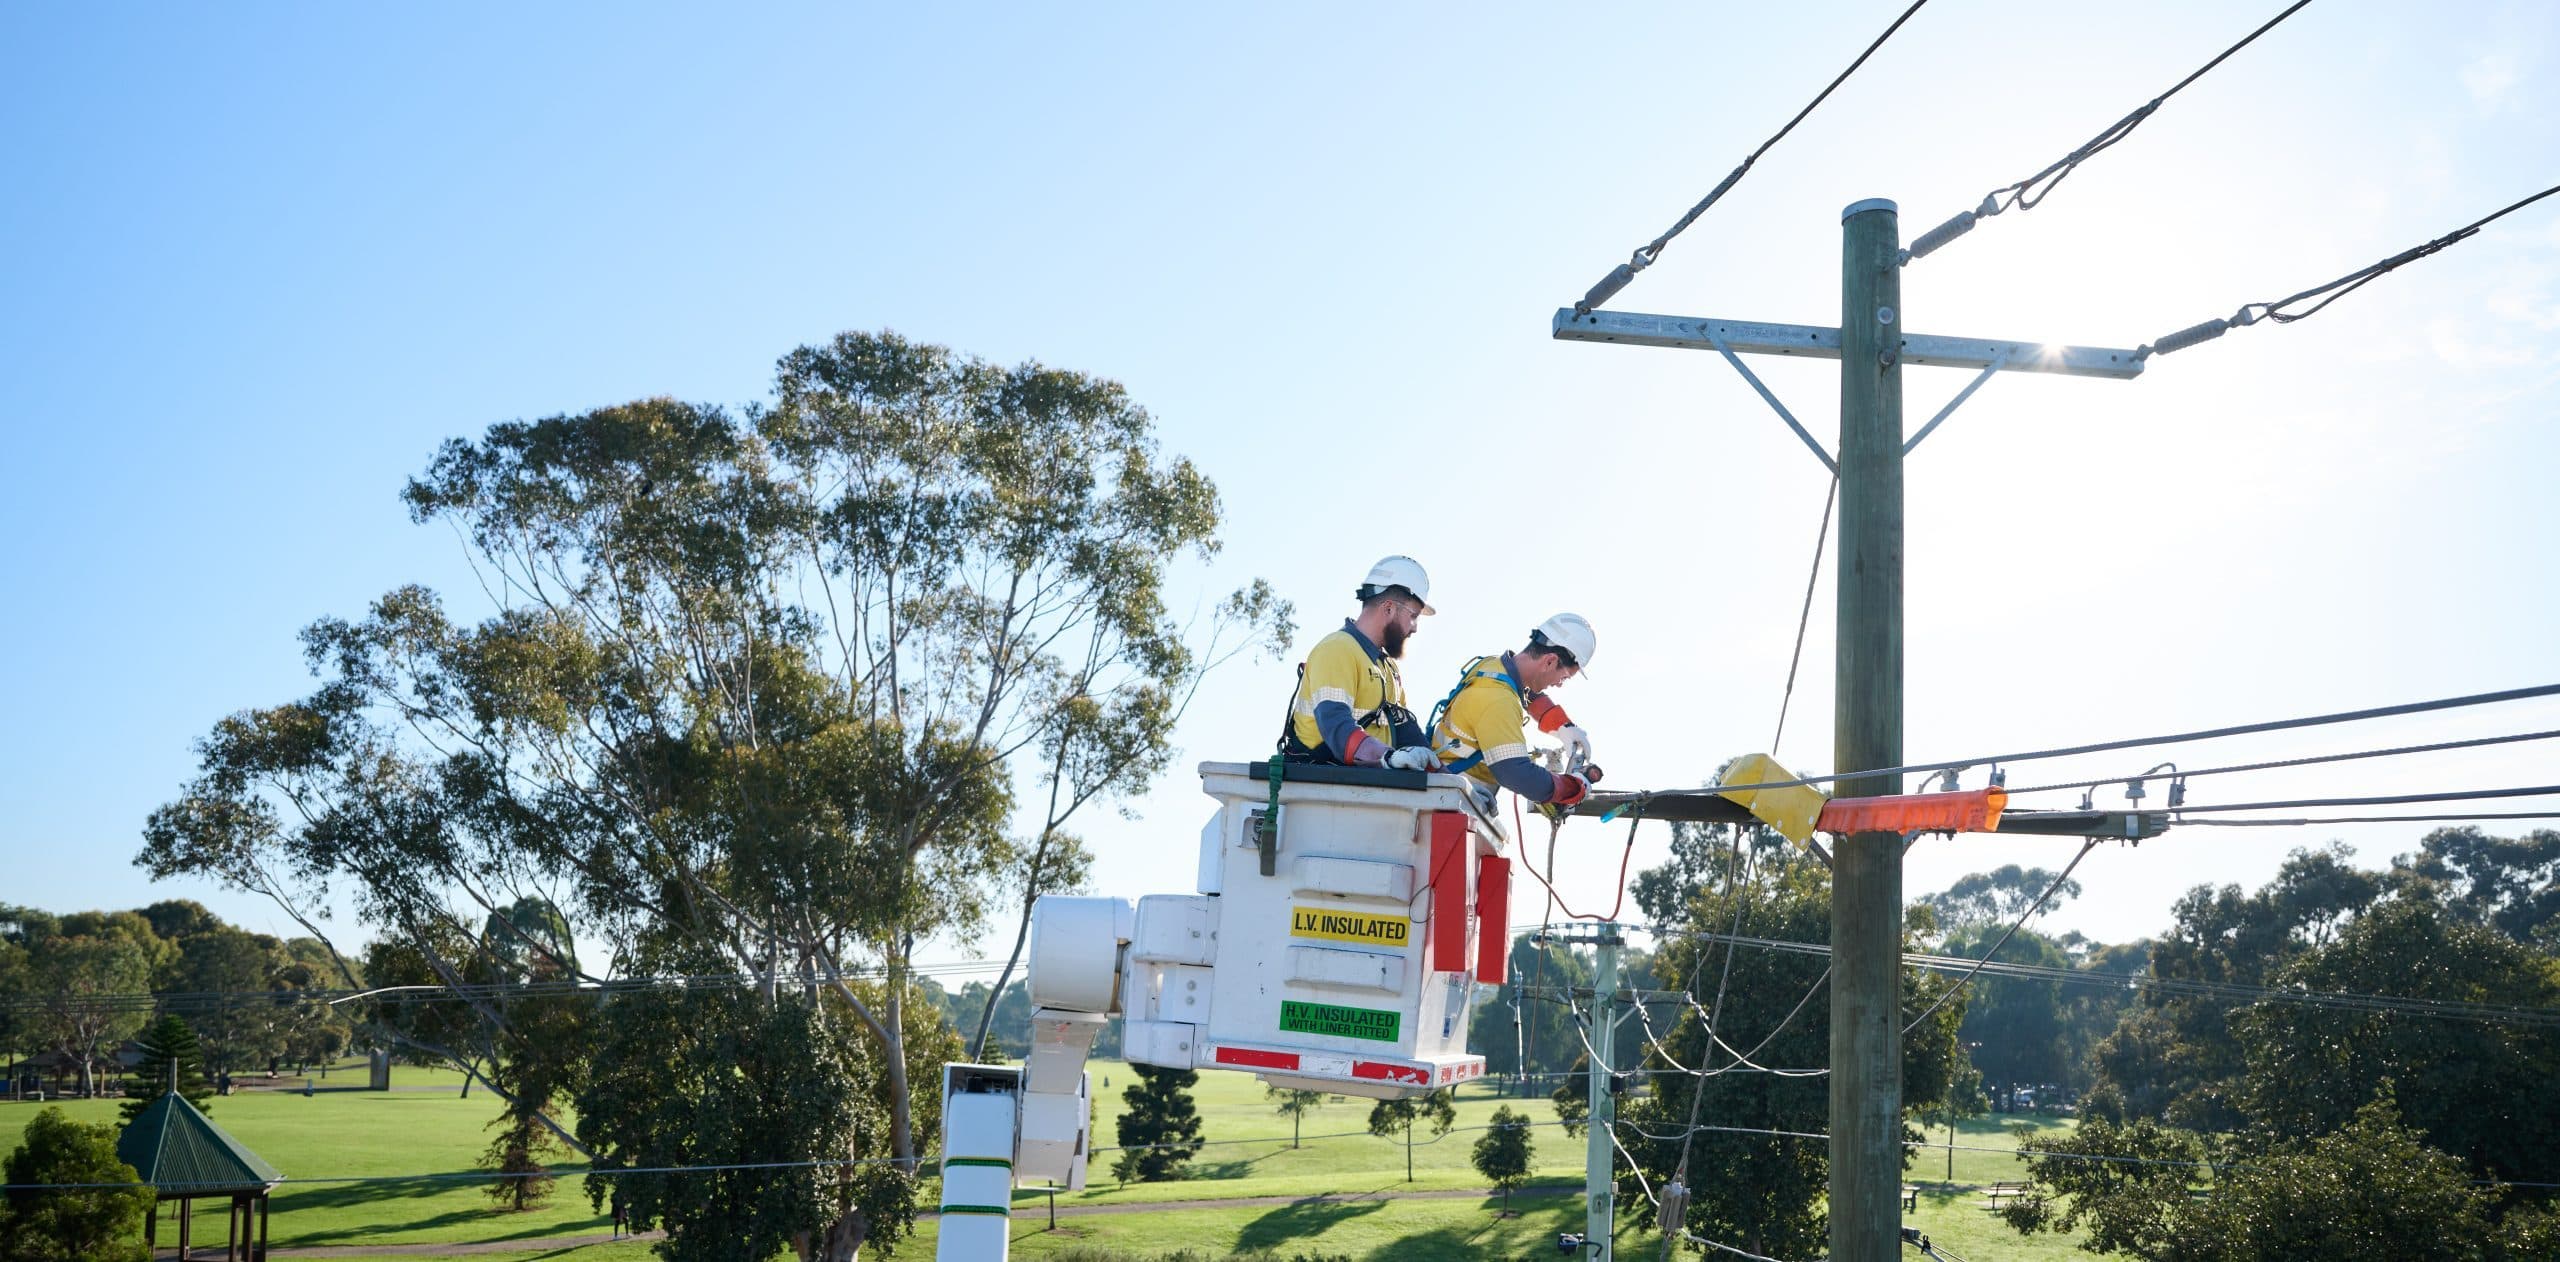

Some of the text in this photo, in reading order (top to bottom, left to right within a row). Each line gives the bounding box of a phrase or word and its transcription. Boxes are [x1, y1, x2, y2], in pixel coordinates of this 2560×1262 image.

[1295, 912, 1406, 940] L.V. INSULATED
[1286, 1003, 1395, 1028] H.V. INSULATED
[1288, 1018, 1390, 1039] WITH LINER FITTED
